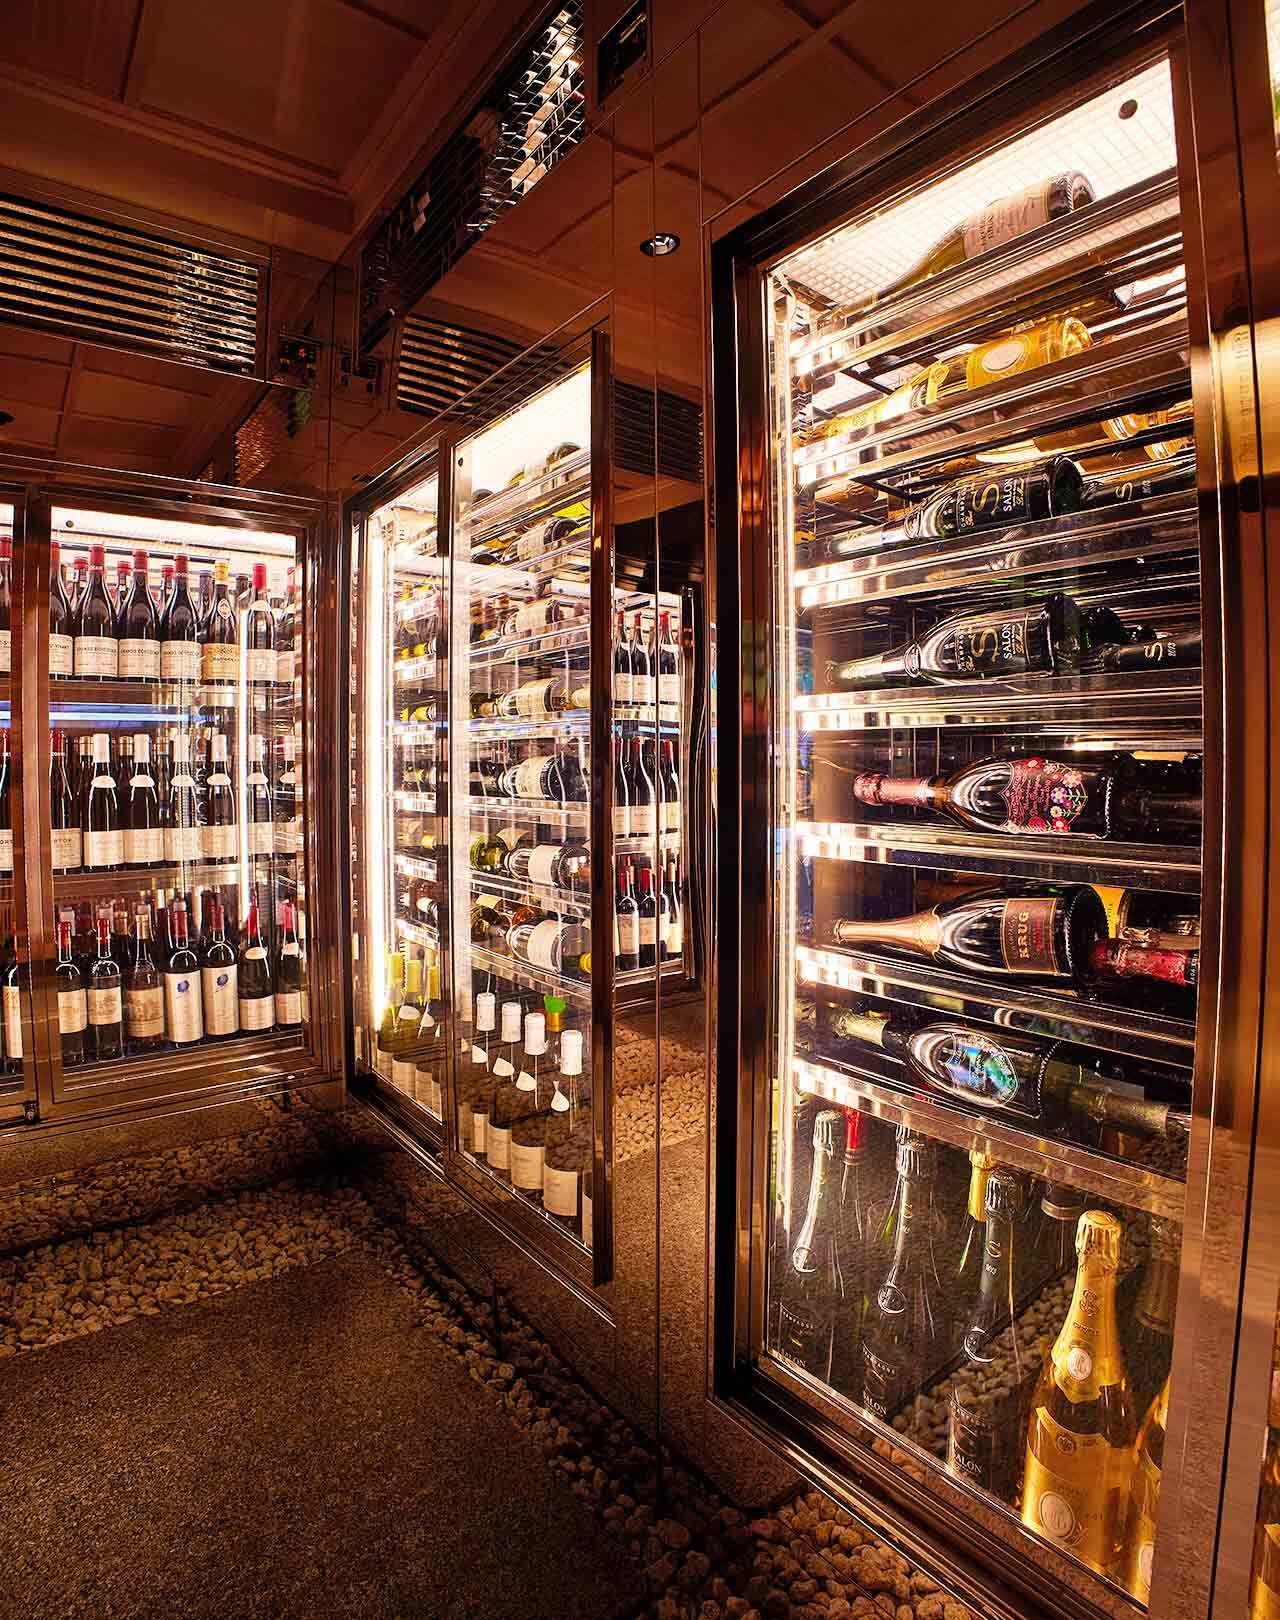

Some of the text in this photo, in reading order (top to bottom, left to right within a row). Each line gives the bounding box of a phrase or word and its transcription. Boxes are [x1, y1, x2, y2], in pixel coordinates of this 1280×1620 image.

[971, 483, 1000, 516] S
[1002, 477, 1013, 512] SALON
[1115, 481, 1133, 500] S
[970, 627, 1000, 664] S
[1002, 623, 1013, 659] SALON
[1143, 642, 1163, 661] S
[1017, 911, 1029, 959] KRUG
[955, 1453, 984, 1473] ALON
